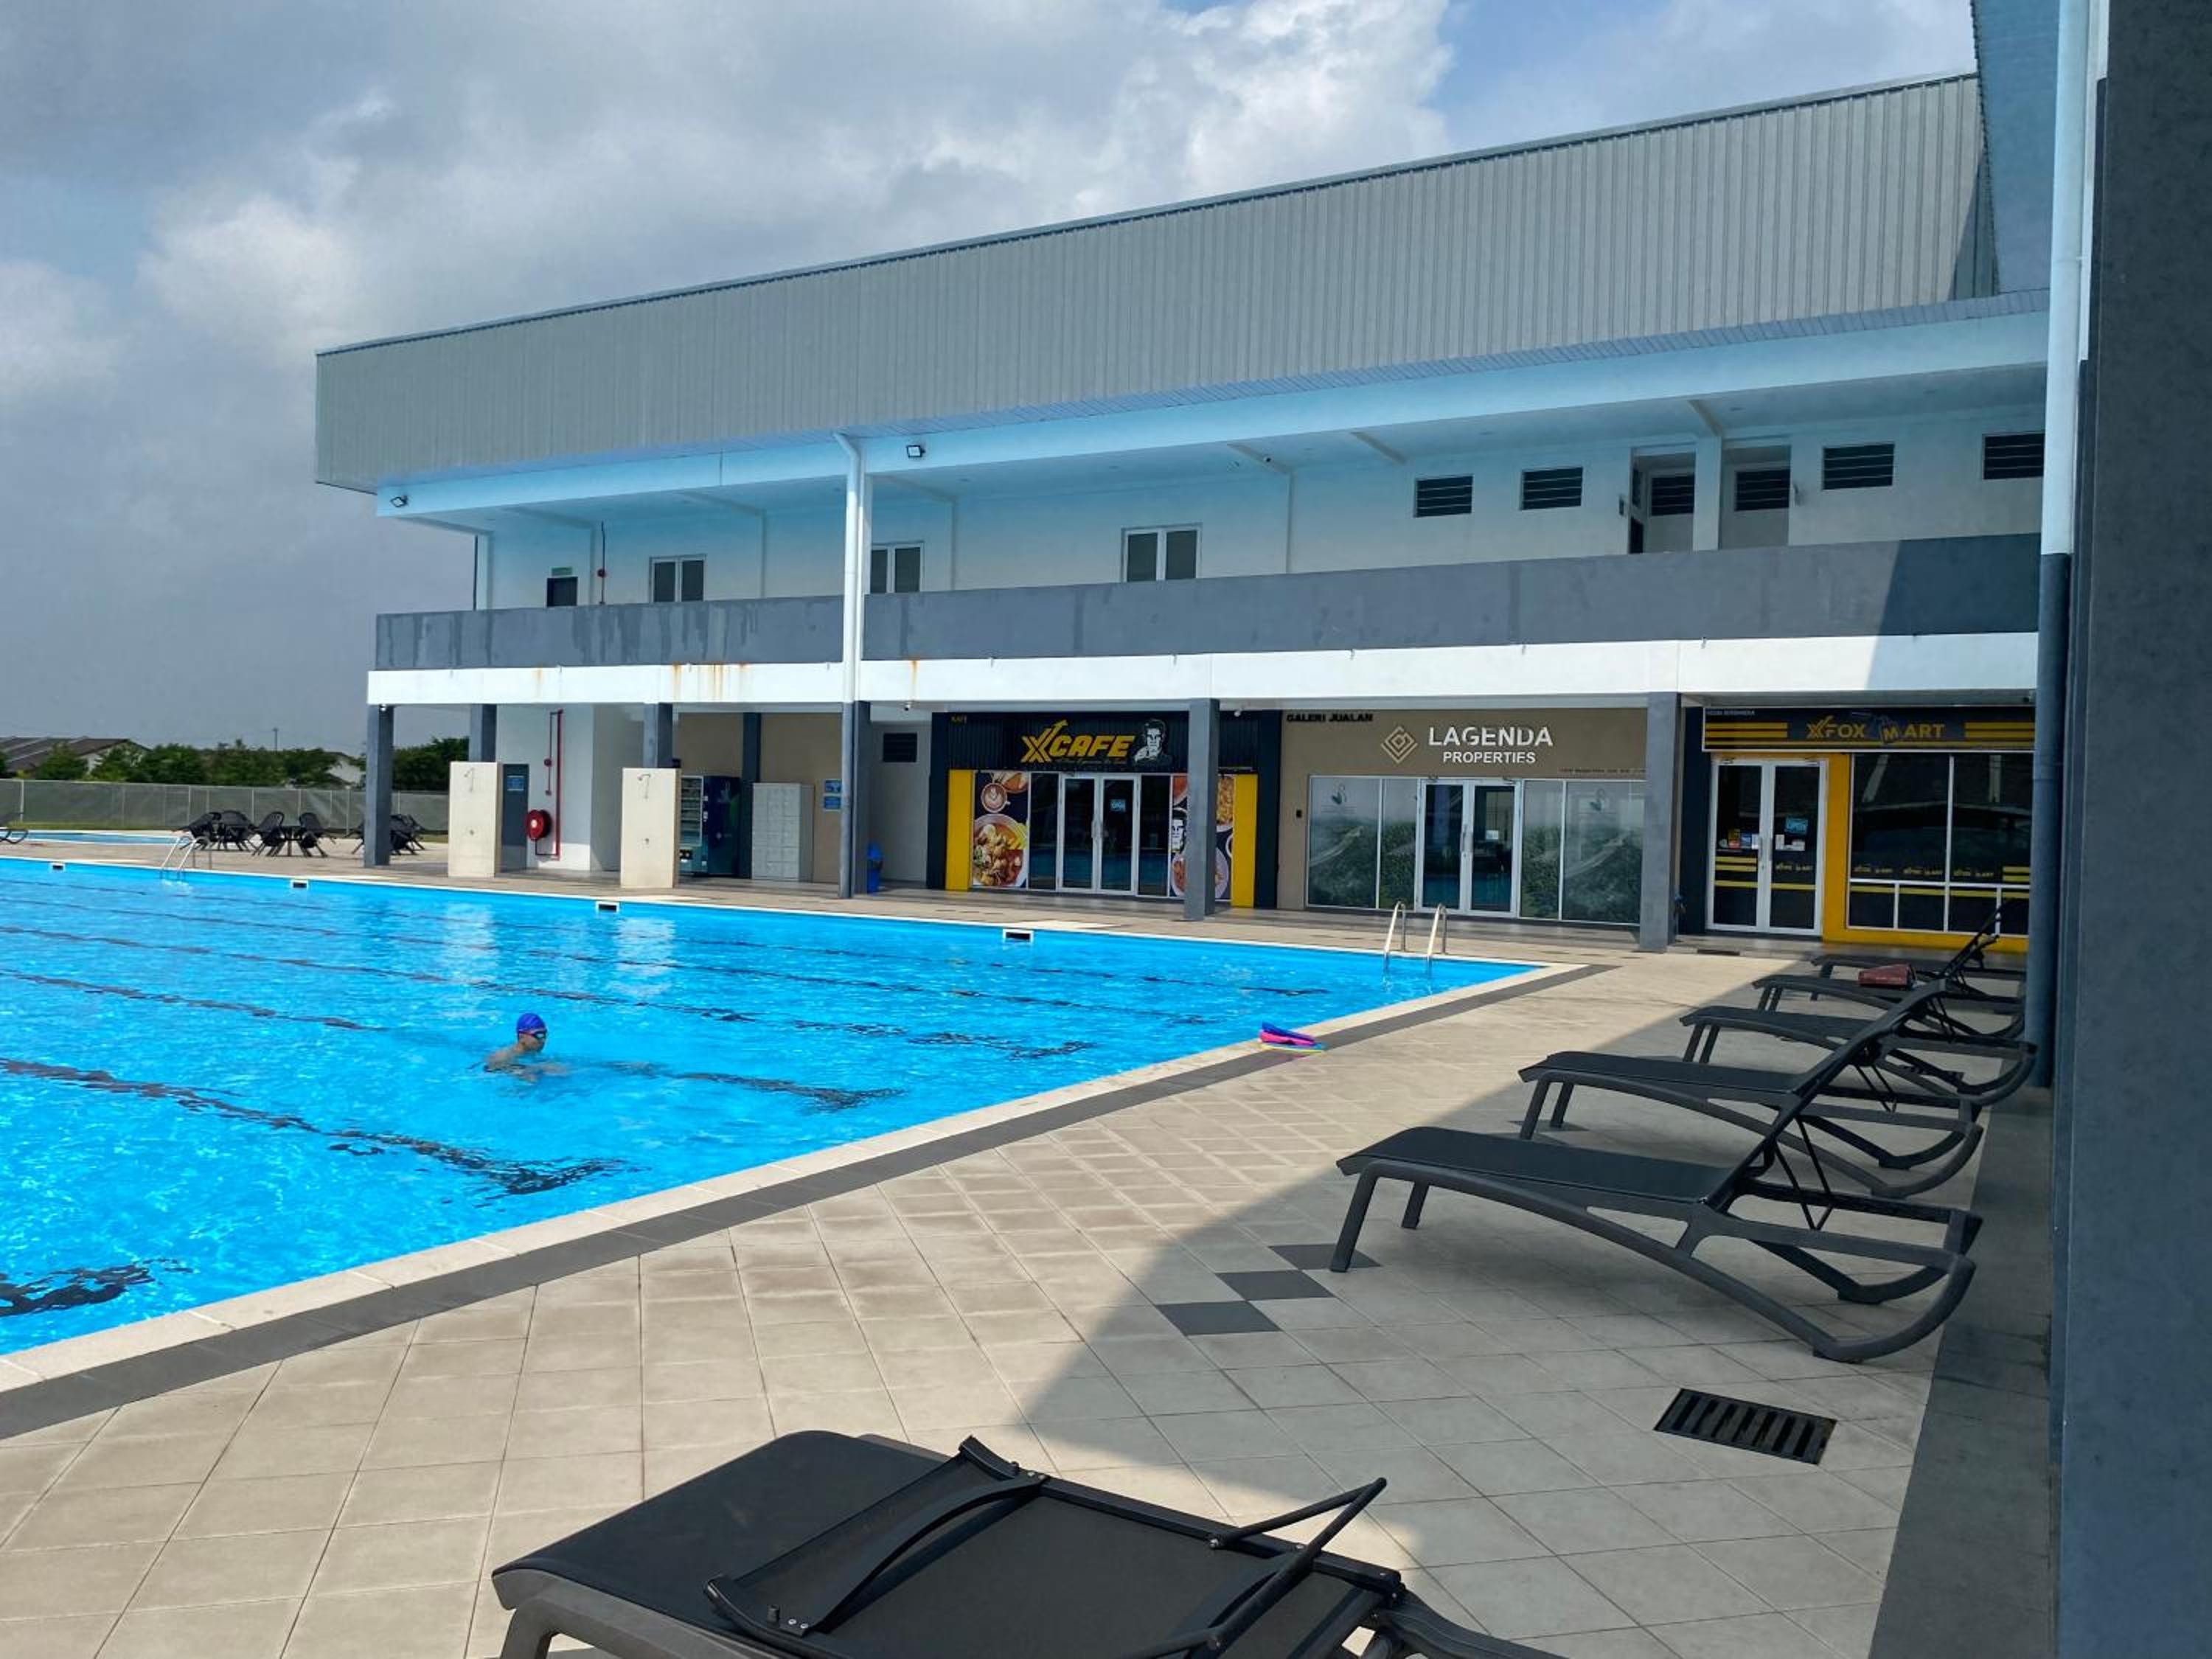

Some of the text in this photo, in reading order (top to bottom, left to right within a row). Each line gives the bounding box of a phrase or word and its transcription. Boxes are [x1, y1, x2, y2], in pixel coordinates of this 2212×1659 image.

[1287, 713, 1374, 722] GALERI JUALAN
[1428, 726, 1554, 746] LAGENDA
[1882, 723, 1945, 740] MART
[1443, 751, 1536, 763] PROPERTIES
